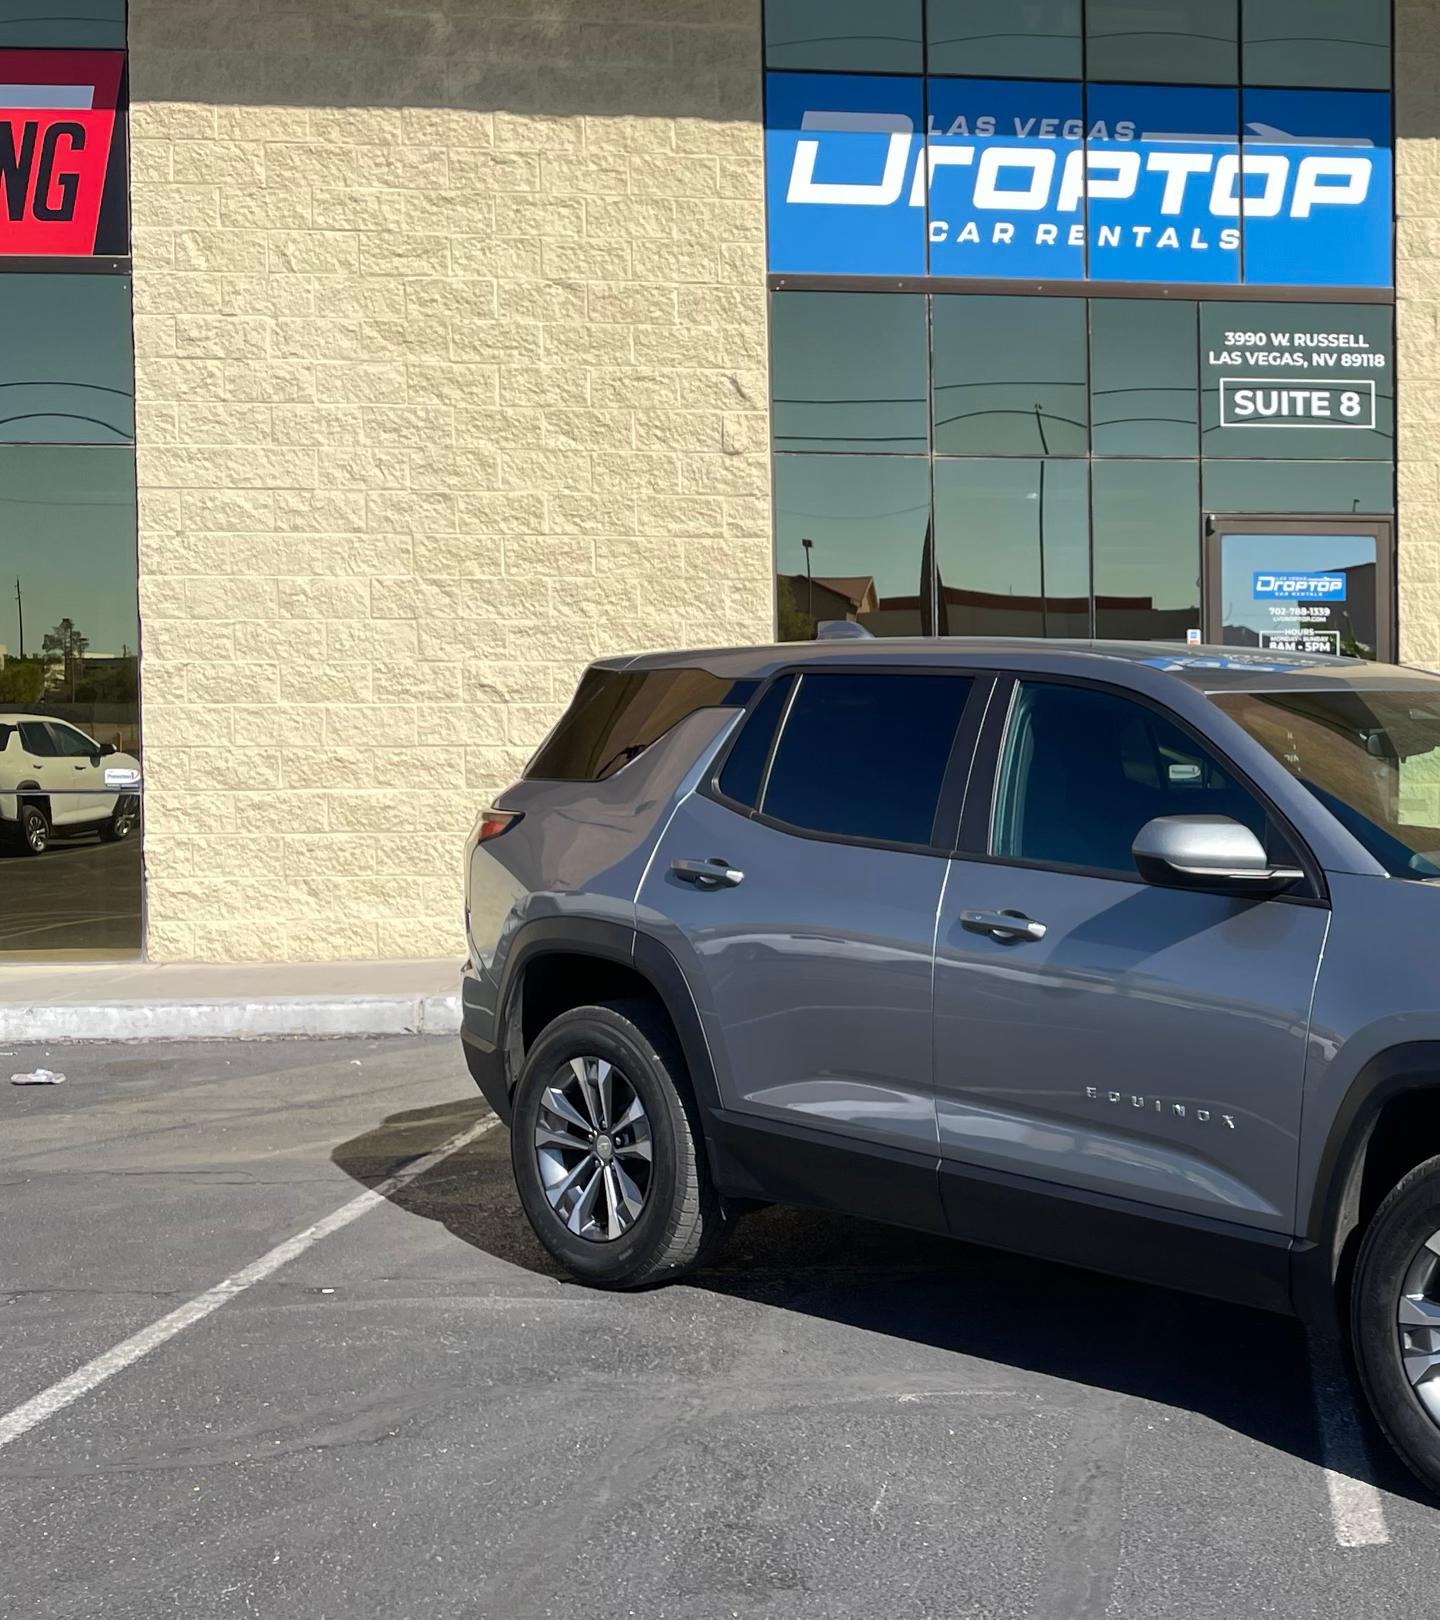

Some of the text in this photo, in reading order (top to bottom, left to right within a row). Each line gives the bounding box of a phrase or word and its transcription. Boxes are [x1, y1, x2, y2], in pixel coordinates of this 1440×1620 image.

[927, 113, 1136, 142] LAS VEGAS
[928, 220, 1242, 250] CAR RENTALS
[1224, 331, 1267, 346] 3990
[1293, 333, 1369, 348] RUSSELL
[1209, 351, 1385, 368] LAS VEGAS, NV 89118
[1234, 390, 1361, 417] SUITE 8
[1284, 628, 1315, 636] HOURS
[1269, 642, 1331, 652] 8AM 5PM
[1085, 1086, 1235, 1129] EQUINOX
